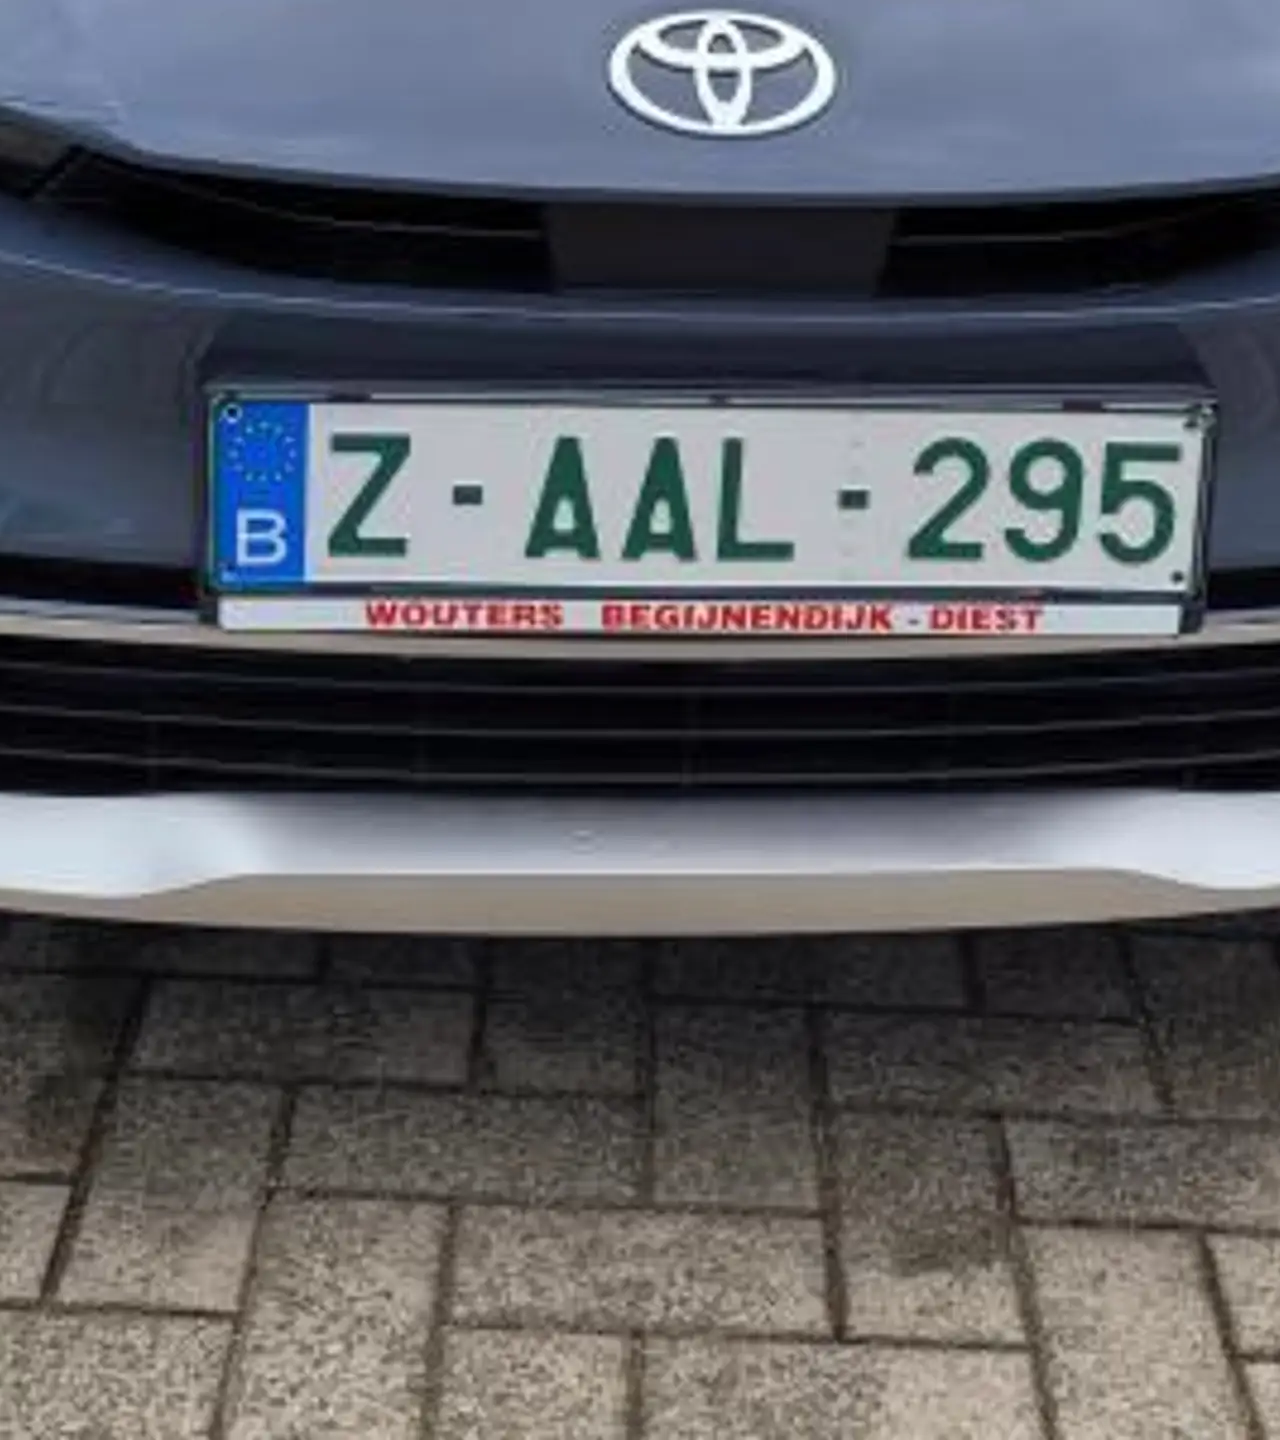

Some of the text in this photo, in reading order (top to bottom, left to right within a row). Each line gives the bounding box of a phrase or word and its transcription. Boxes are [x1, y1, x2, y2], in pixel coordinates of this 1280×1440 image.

[235, 508, 287, 566] B
[365, 601, 563, 630] WOUTERS
[601, 603, 892, 632] BEGIJNENDIJK
[929, 606, 1045, 633] DIEST
